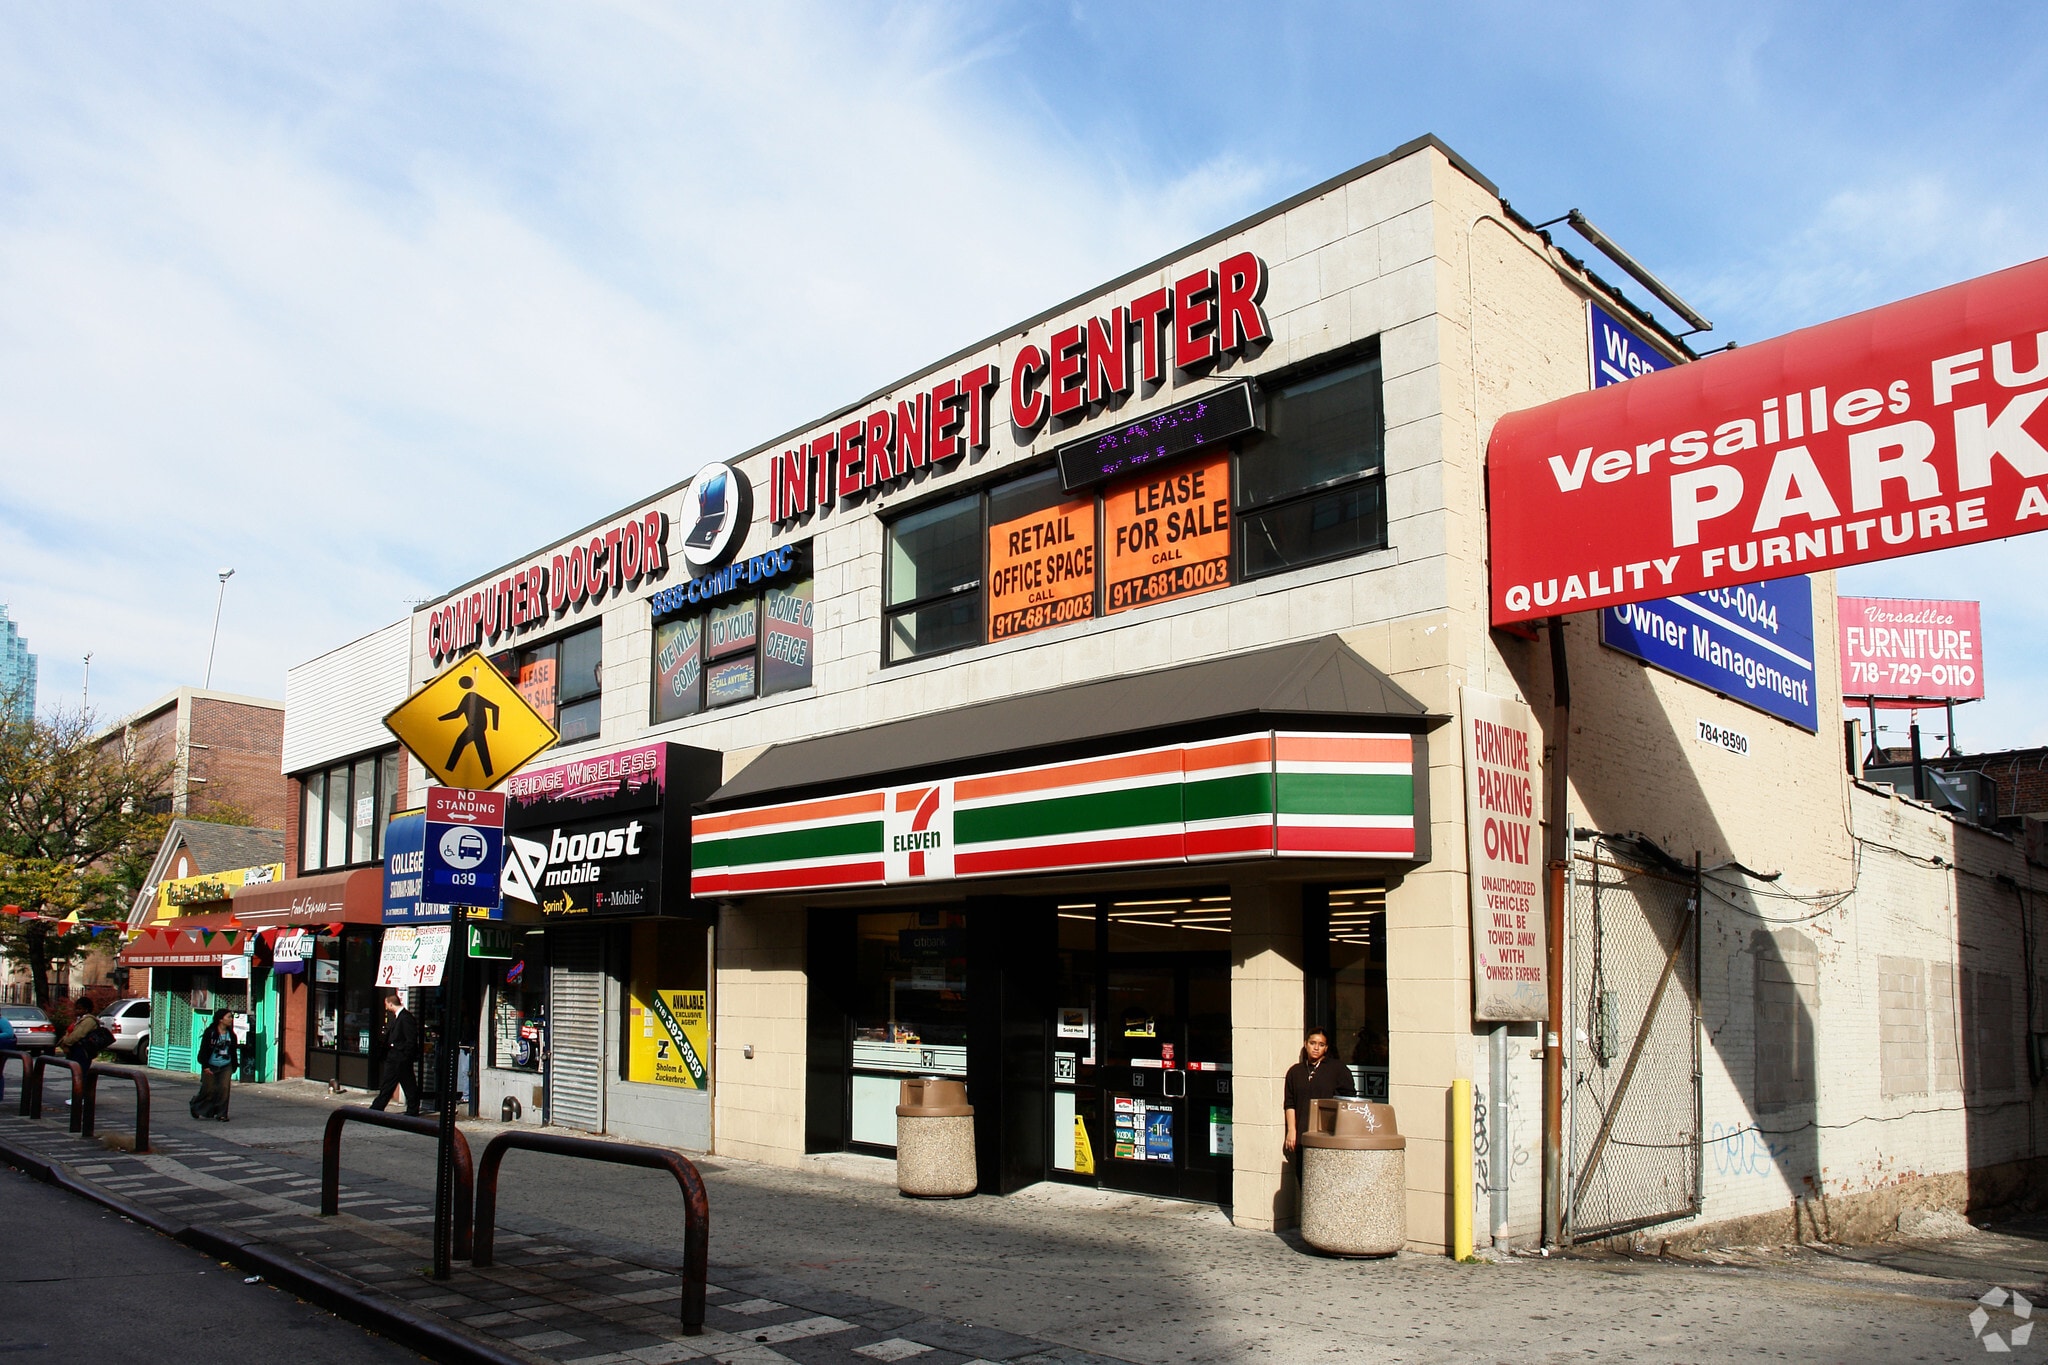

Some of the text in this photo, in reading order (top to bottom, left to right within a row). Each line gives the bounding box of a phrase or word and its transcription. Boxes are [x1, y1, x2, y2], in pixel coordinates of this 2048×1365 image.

[770, 364, 995, 524] INTERNET
[1010, 250, 1269, 430] CENTER
[1547, 379, 1912, 493] Versailles
[1669, 388, 2048, 548] PARK
[1134, 471, 1205, 516] LEASE
[1009, 517, 1075, 557] RETAIL
[1116, 499, 1228, 557] FOR SALE
[1152, 549, 1182, 564] CALL
[1504, 485, 2048, 613] QUALITY FURNITURE A
[428, 510, 665, 660] COMPUTER DOCTOR
[652, 545, 793, 616] 888-COMP-DOC
[993, 545, 1093, 597] OFFICE SPACE
[1114, 559, 1227, 606] 917-681-0003
[768, 595, 802, 625] HOME
[1028, 589, 1054, 603] CALL
[1698, 586, 1779, 635] 3-0044
[712, 611, 755, 646] TO YOUR
[996, 594, 1092, 636] 917-681-0003
[1864, 606, 1955, 625] Versailles
[658, 622, 699, 674] WE WILL
[766, 631, 807, 666] OFFICE
[1613, 603, 1809, 706] Owner Management
[1847, 626, 1973, 660] FURNITURE
[524, 665, 549, 688] LEASE
[672, 653, 700, 697] COME
[715, 672, 749, 688] CALL ANYTIME
[1850, 662, 1975, 687] 718-729-0110
[534, 686, 556, 709] SALE
[1474, 719, 1530, 773] FURNITURE
[1699, 722, 1747, 753] 784-8590
[508, 750, 657, 799] BRIDGE WIRELESS
[437, 800, 495, 813] STANDING
[458, 791, 476, 800] NO
[1478, 767, 1532, 819] PARKING
[548, 820, 643, 865] boost
[896, 786, 940, 877] 7
[1484, 817, 1531, 865] ONLY
[391, 850, 423, 875] COLLEGE
[545, 862, 600, 887] mobile
[452, 873, 476, 885] Q39
[1481, 875, 1536, 896] UNAUTHORIZED
[290, 897, 327, 919] Food Express
[542, 899, 563, 915] Sprint
[1487, 894, 1530, 912] VEHICLES
[1493, 913, 1526, 929] WILL BE
[472, 928, 511, 949] ATM
[1488, 930, 1536, 947] TOWED AWAY
[1498, 948, 1525, 964] WITH
[1486, 966, 1541, 982] OWNERS EXPENSE
[673, 995, 704, 1010] AVAILABLE
[675, 1011, 702, 1019] EXCLUSIVE
[665, 1016, 702, 1079] 392-5959
[655, 1073, 687, 1084] Zuckerbrot
[656, 1063, 683, 1073] Sholom &
